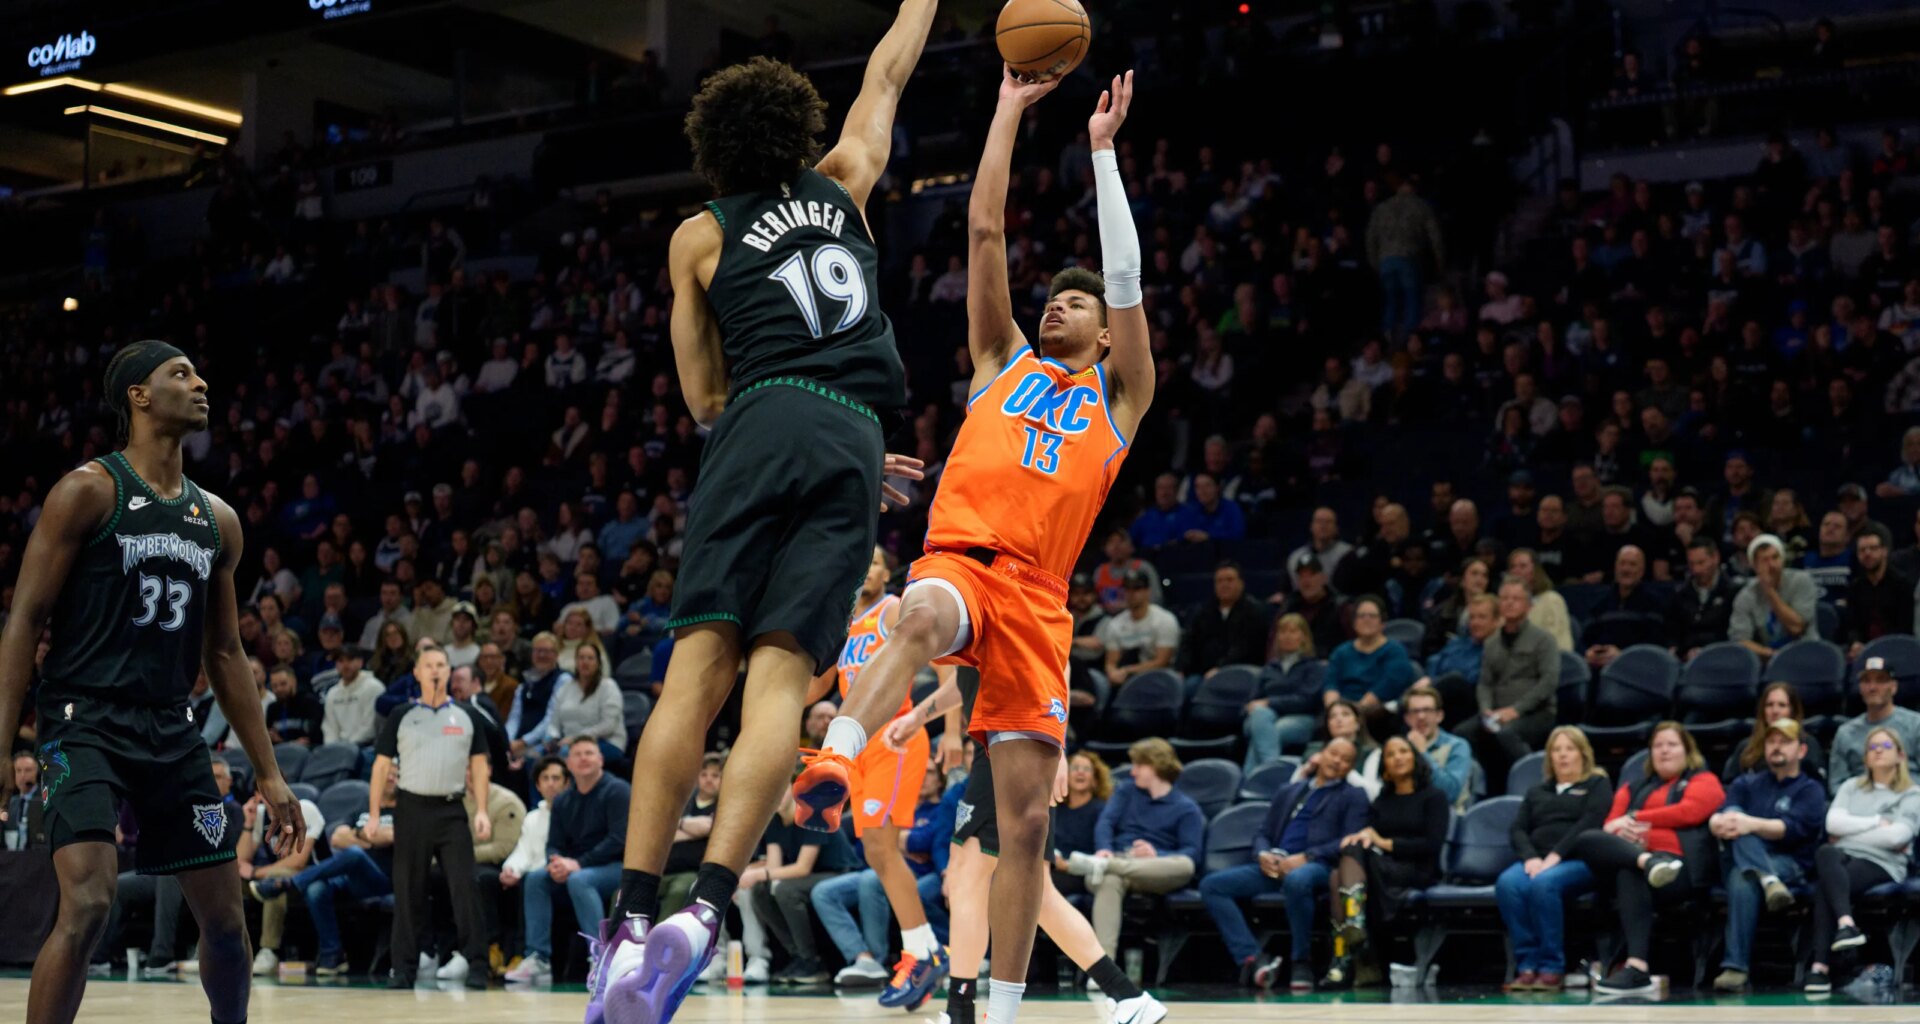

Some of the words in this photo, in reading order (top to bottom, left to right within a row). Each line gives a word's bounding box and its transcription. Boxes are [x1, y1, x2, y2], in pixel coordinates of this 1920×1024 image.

[742, 200, 846, 253] BERINGER
[767, 243, 868, 339] 19
[1000, 371, 1099, 434] OKC
[1021, 425, 1064, 475] 13
[183, 515, 209, 527] sezzle
[132, 571, 192, 631] 33
